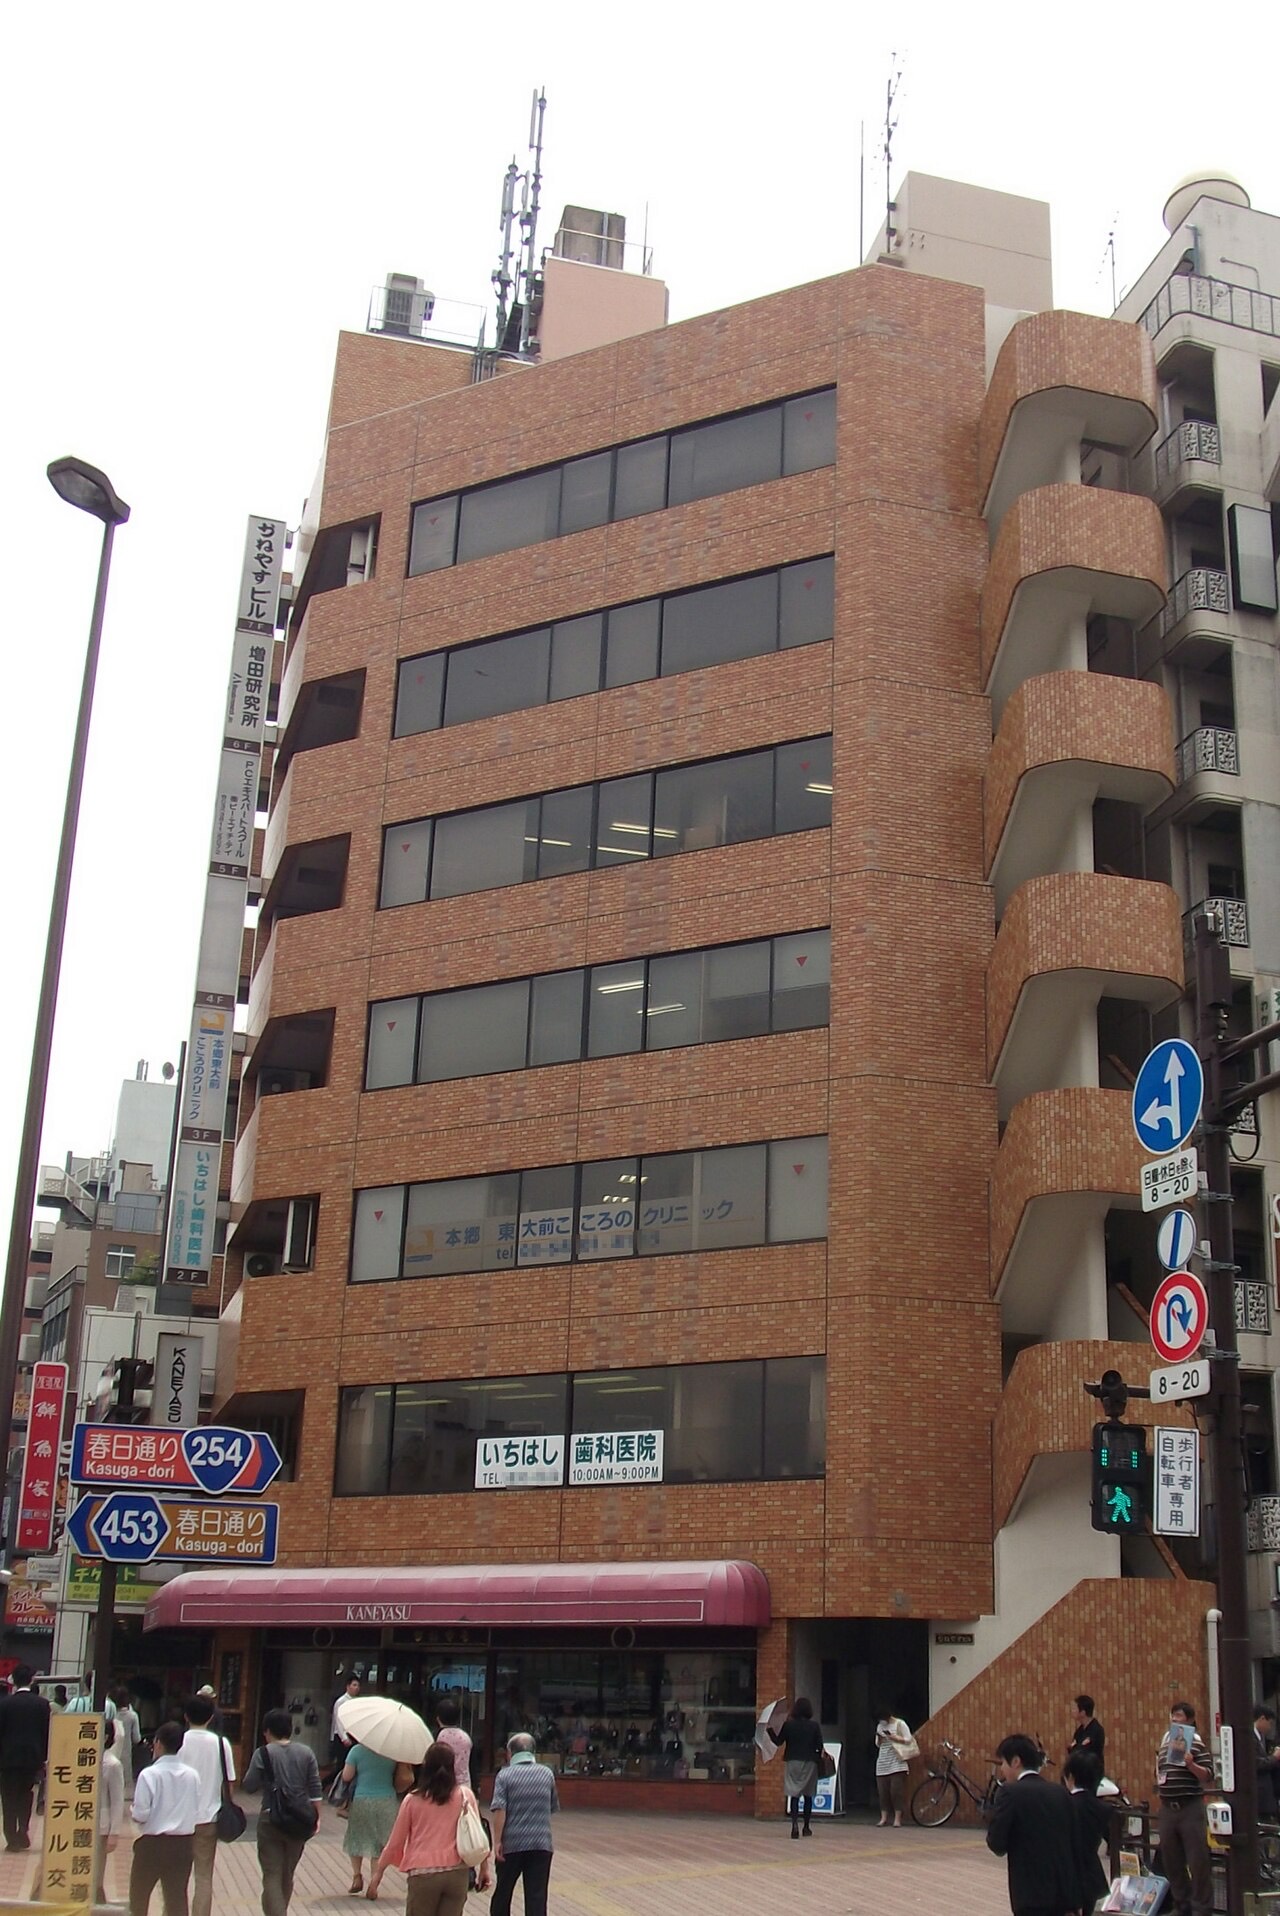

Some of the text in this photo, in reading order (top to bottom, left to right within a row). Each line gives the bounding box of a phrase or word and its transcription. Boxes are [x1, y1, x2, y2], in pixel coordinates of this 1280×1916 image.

[247, 522, 275, 619] かねやすビル
[241, 645, 266, 728] 増田研究所
[206, 995, 225, 1004] 4F
[189, 1037, 206, 1120] こころのクリニック
[192, 1130, 211, 1140] 3F
[168, 1347, 187, 1423] KANEYASU
[87, 1433, 178, 1462] 春日通り
[189, 1436, 243, 1467] 254
[482, 1438, 559, 1468] いちはし
[574, 1433, 657, 1465] 歯科医院
[1161, 1436, 1176, 1487] 自転車
[85, 1461, 175, 1479] Kasuga-dori
[1177, 1437, 1194, 1491] 歩行者
[175, 1508, 266, 1537] 春日通り
[1169, 1491, 1185, 1527] 専用
[101, 1510, 159, 1545] 453
[175, 1537, 264, 1555] Kasuga-dori
[12, 1602, 46, 1613] カレー
[346, 1605, 412, 1620] KANEYASU
[69, 1721, 98, 1902] 高齢者保護誘導
